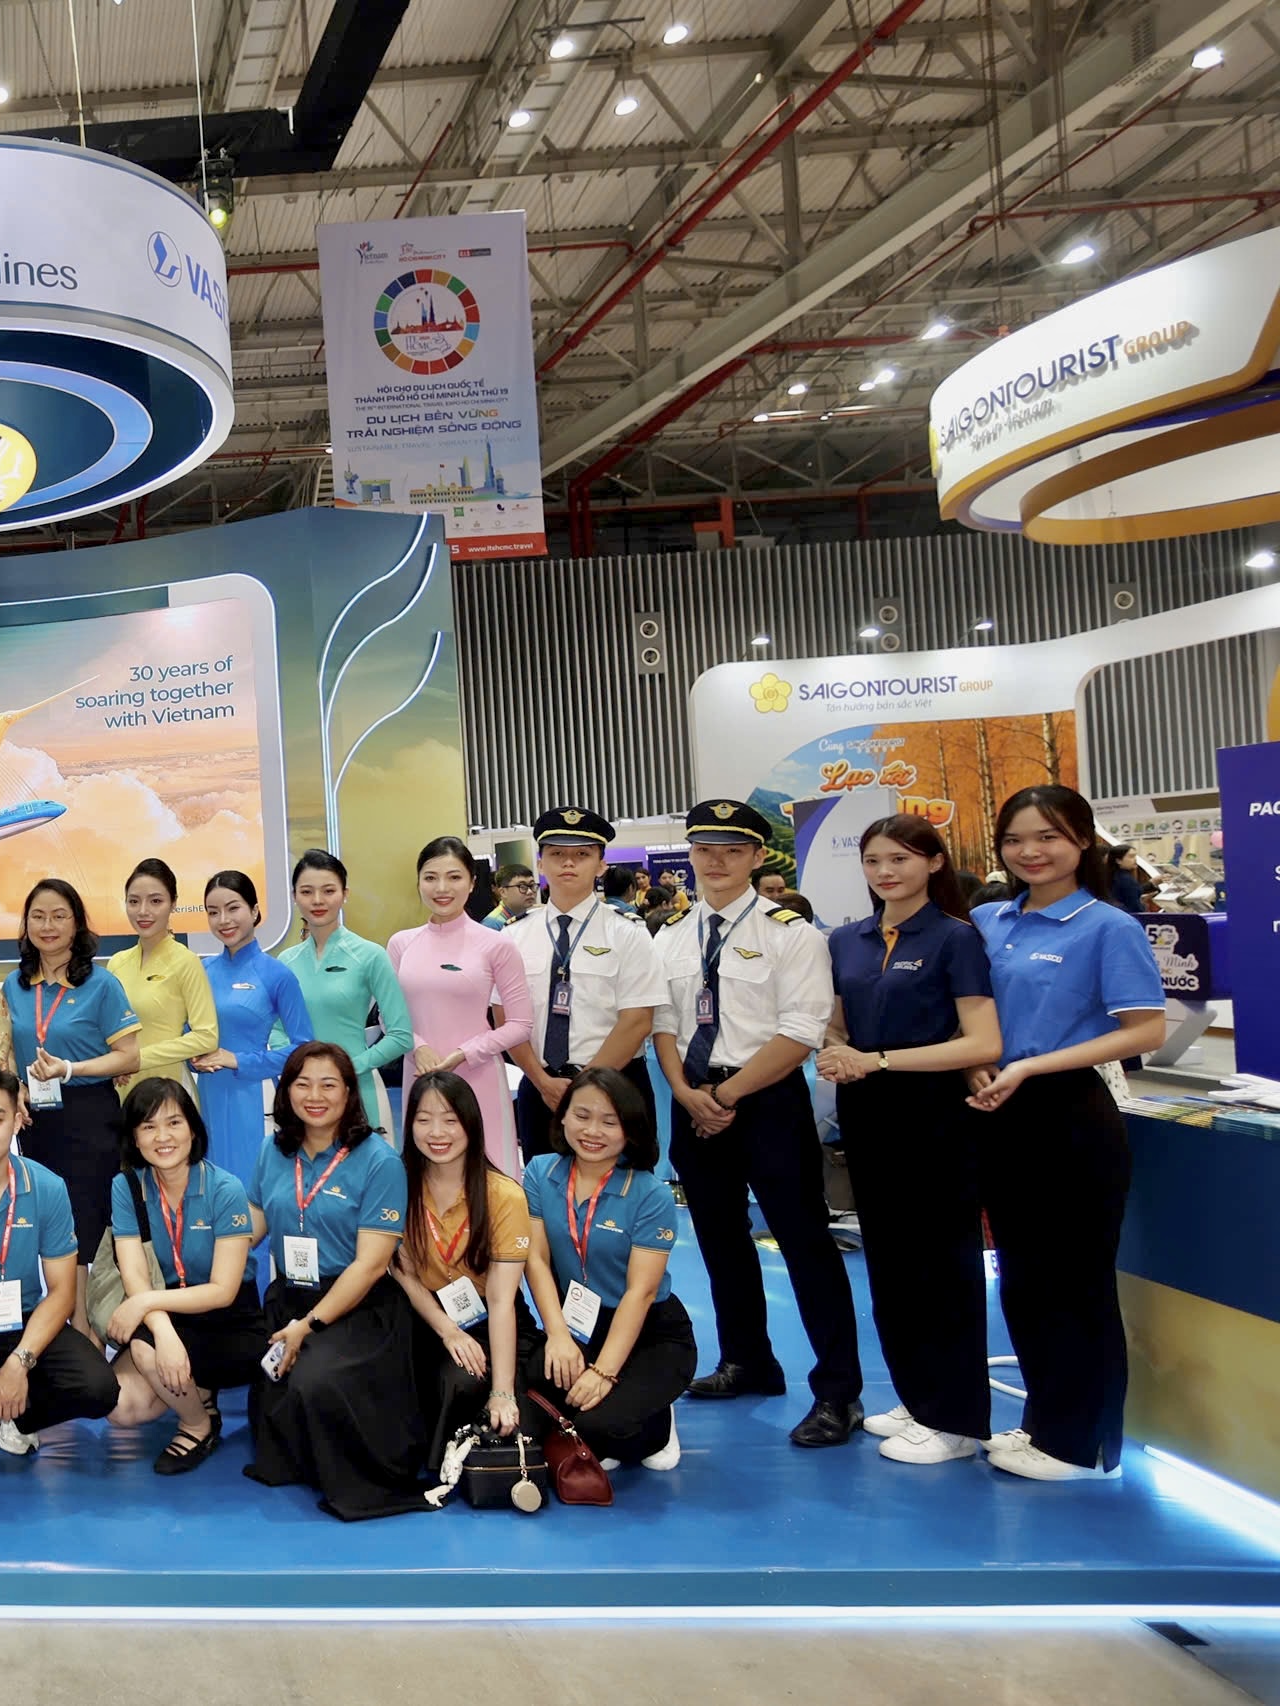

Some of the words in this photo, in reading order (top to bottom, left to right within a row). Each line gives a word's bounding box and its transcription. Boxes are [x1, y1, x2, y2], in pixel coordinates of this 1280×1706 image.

[413, 383, 426, 392] DU
[426, 382, 447, 395] LỊCH
[941, 334, 1120, 447] SAIGONTOURIST
[1123, 320, 1192, 358] GROUP
[436, 390, 460, 400] MINH
[500, 387, 509, 395] 19
[367, 416, 386, 425] DU
[391, 413, 420, 427] LỊCH
[424, 409, 453, 421] BỀN
[346, 426, 378, 439] TRẢI
[381, 425, 434, 437] NGHIỆM
[129, 665, 154, 682] 30
[158, 662, 210, 683] years
[213, 654, 234, 673] of
[75, 689, 145, 709] soaring
[150, 681, 234, 704] together
[799, 676, 958, 701] SAIGONTOURIST
[958, 679, 994, 693] GROUP
[104, 711, 147, 729] with
[151, 704, 235, 724] Vietnam
[231, 1213, 248, 1228] 30
[380, 1207, 401, 1222] 30
[655, 1227, 675, 1241] 30
